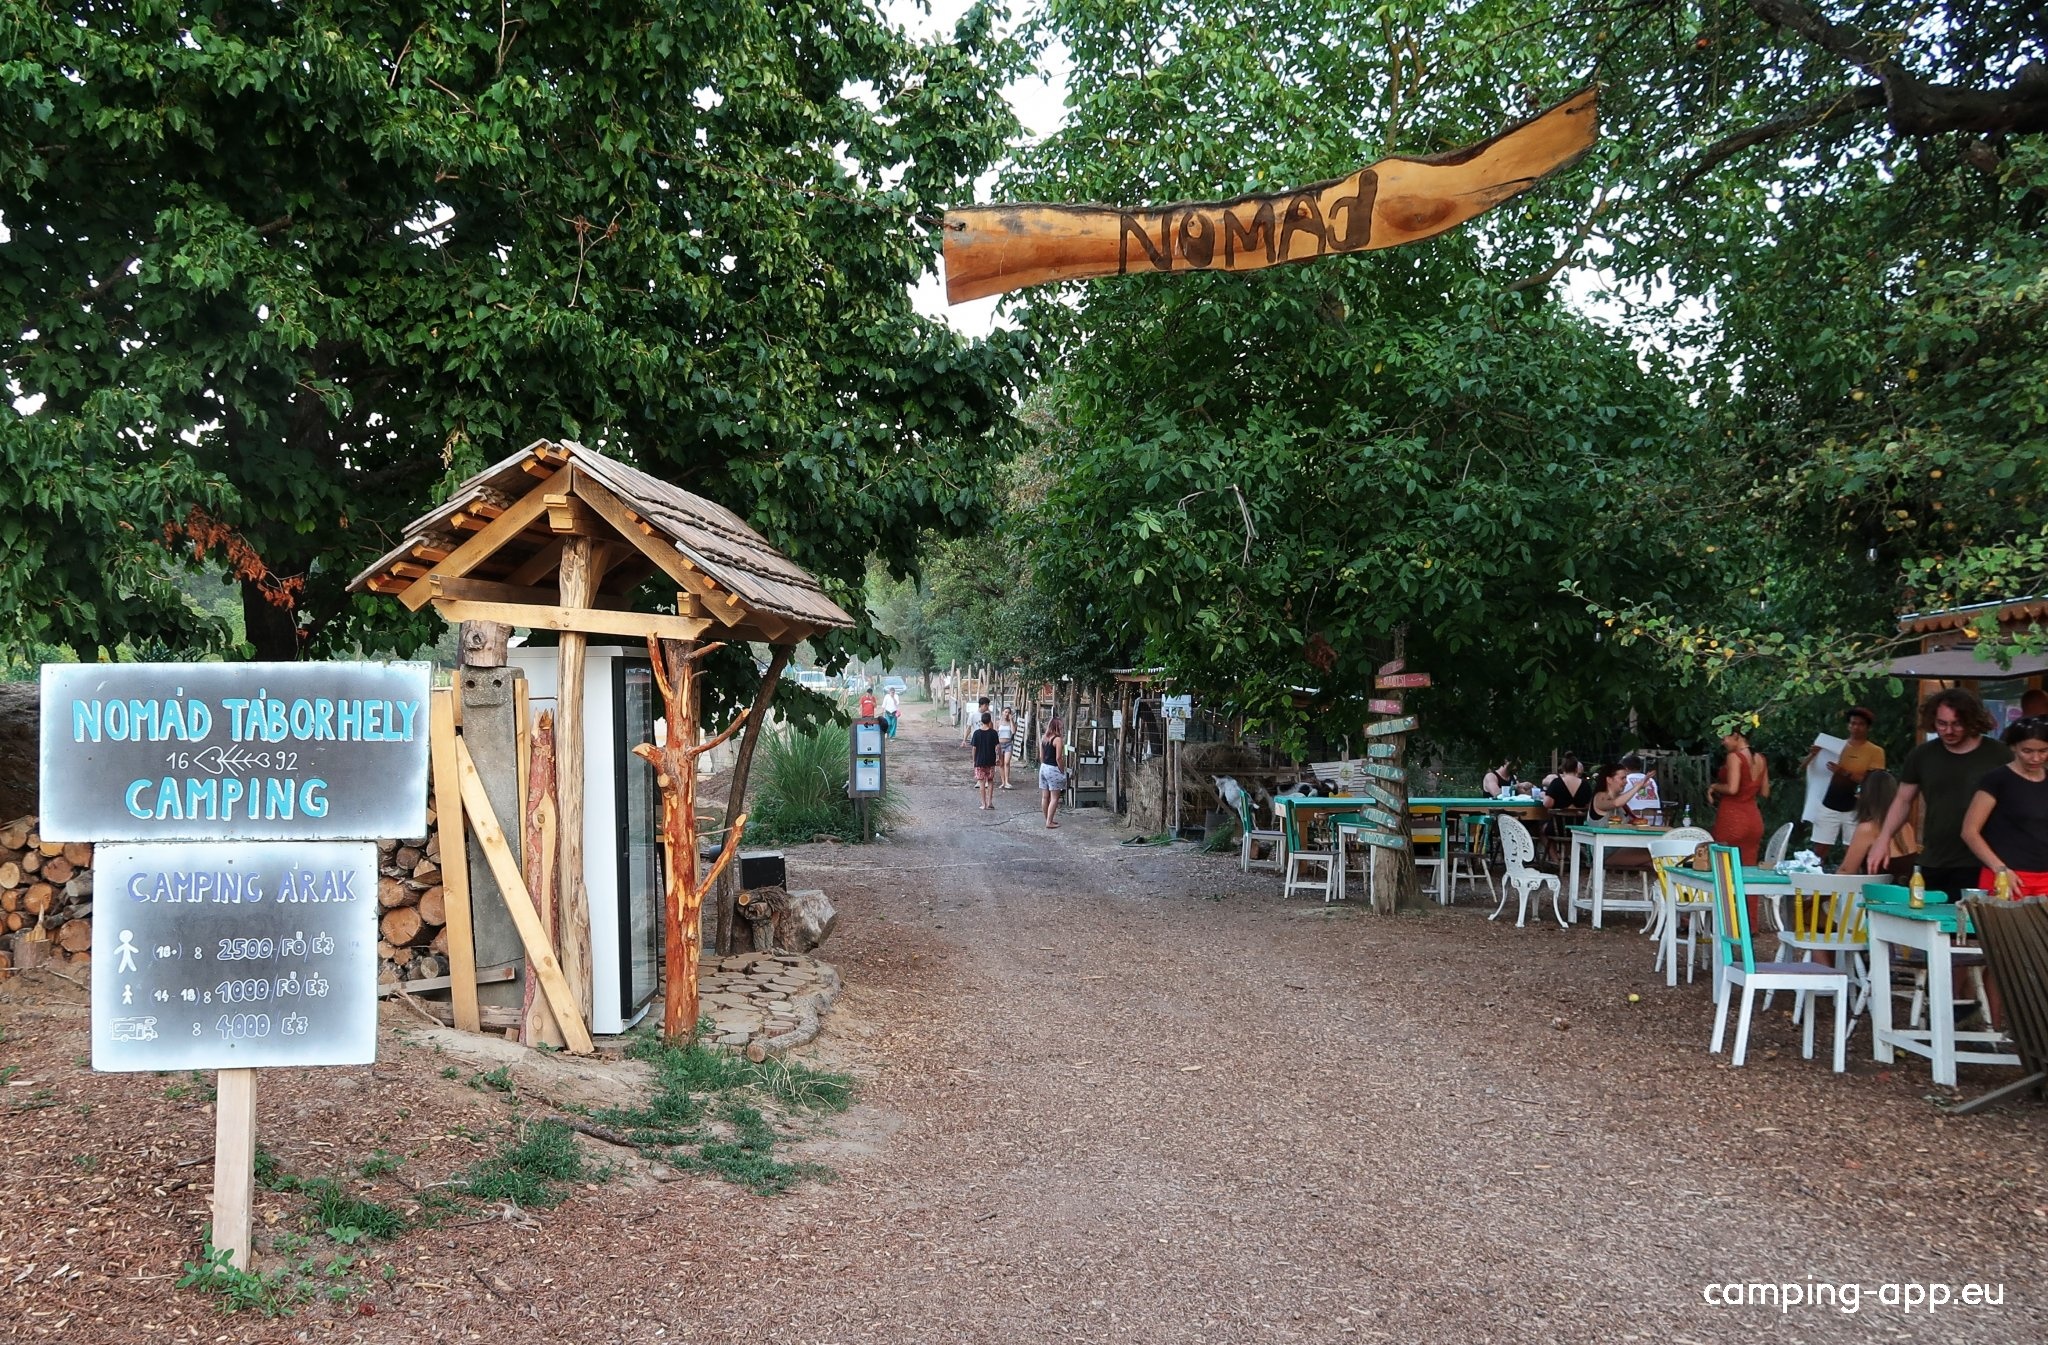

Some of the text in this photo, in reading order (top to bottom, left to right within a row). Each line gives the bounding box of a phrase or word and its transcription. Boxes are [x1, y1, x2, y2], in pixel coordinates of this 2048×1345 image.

[72, 686, 420, 743] NOMÁD TÁBORHELY
[166, 751, 299, 771] 16 92
[125, 777, 330, 821] CAMPING
[127, 861, 357, 904] CAMPING ÁRAK
